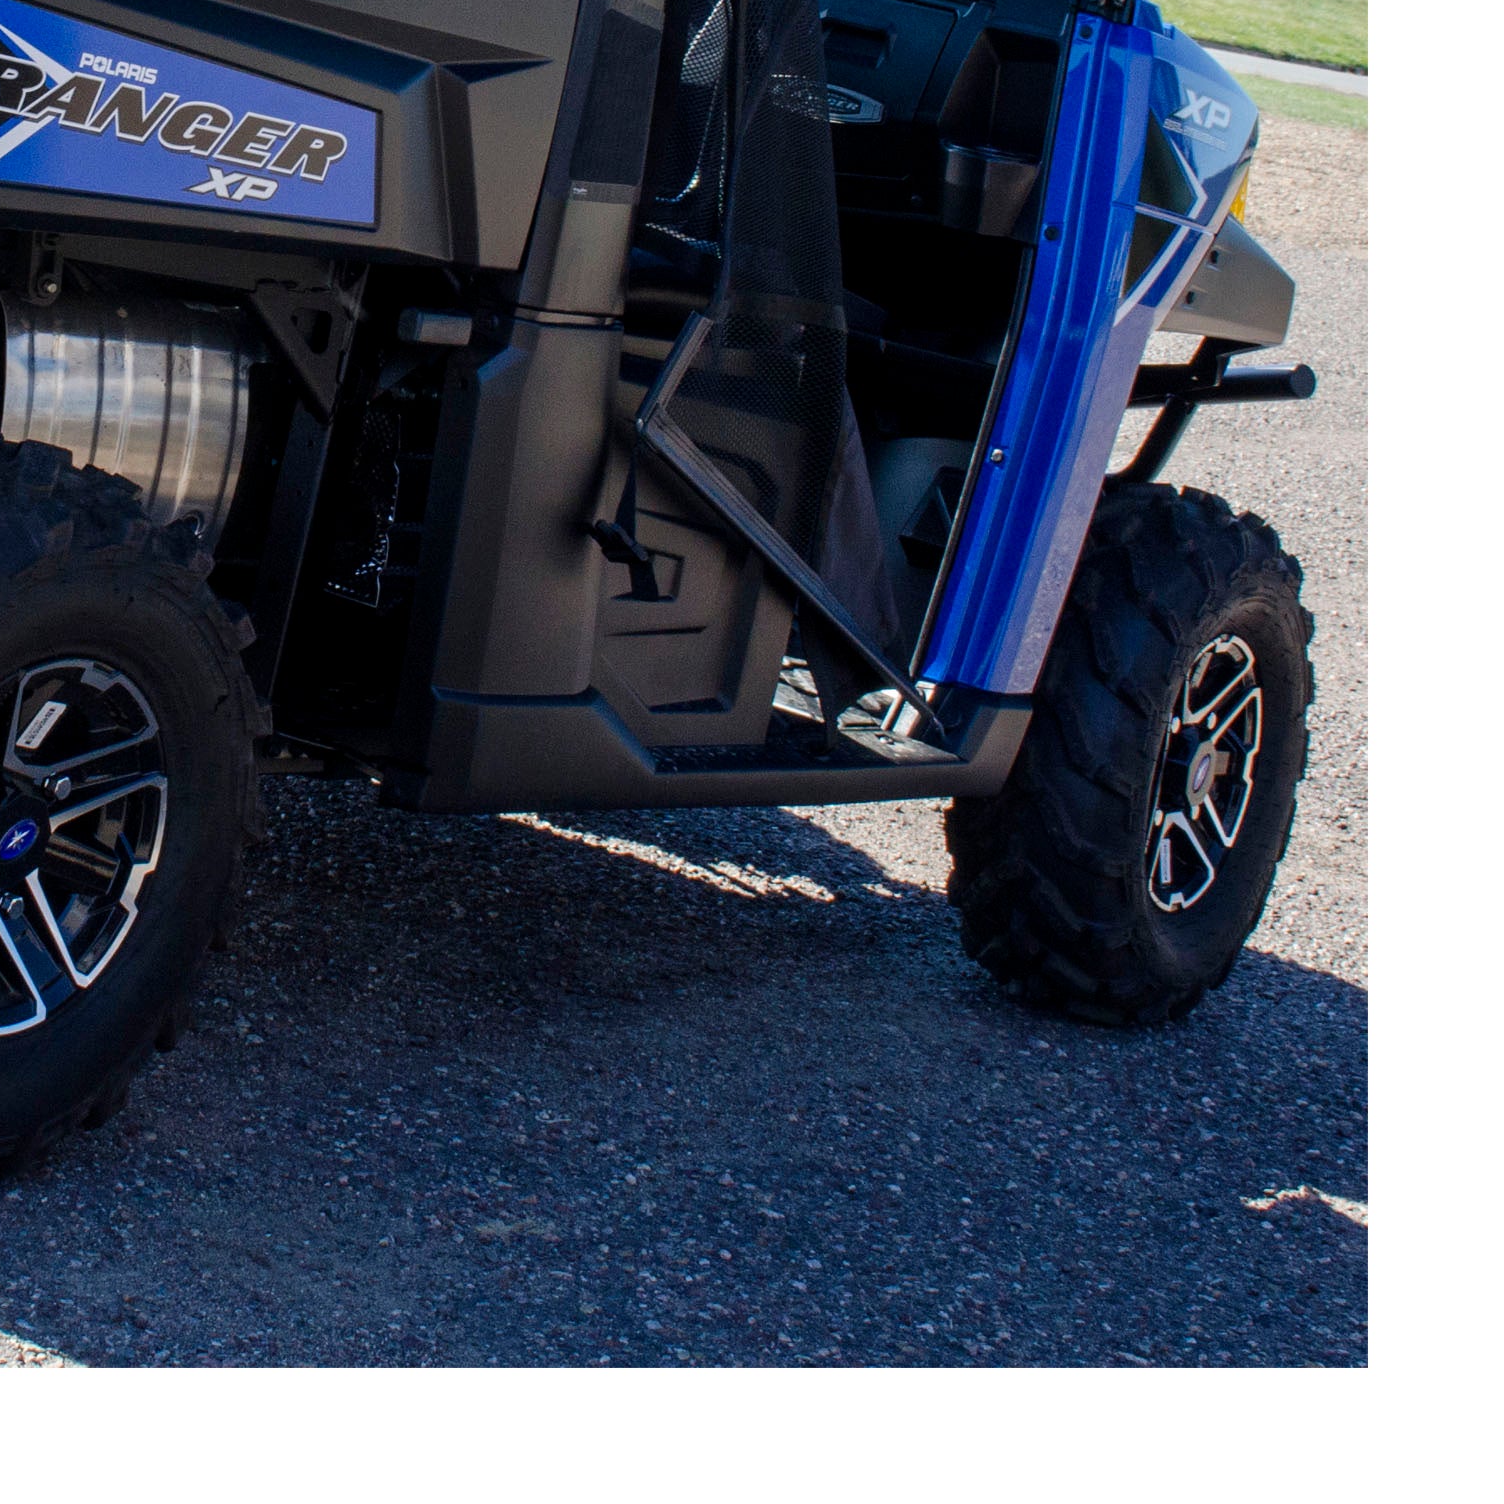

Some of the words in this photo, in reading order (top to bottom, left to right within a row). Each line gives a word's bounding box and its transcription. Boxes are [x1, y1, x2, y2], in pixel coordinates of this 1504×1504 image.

[79, 52, 158, 85] POLARIS
[1173, 87, 1232, 129] XP
[185, 165, 280, 202] XP
